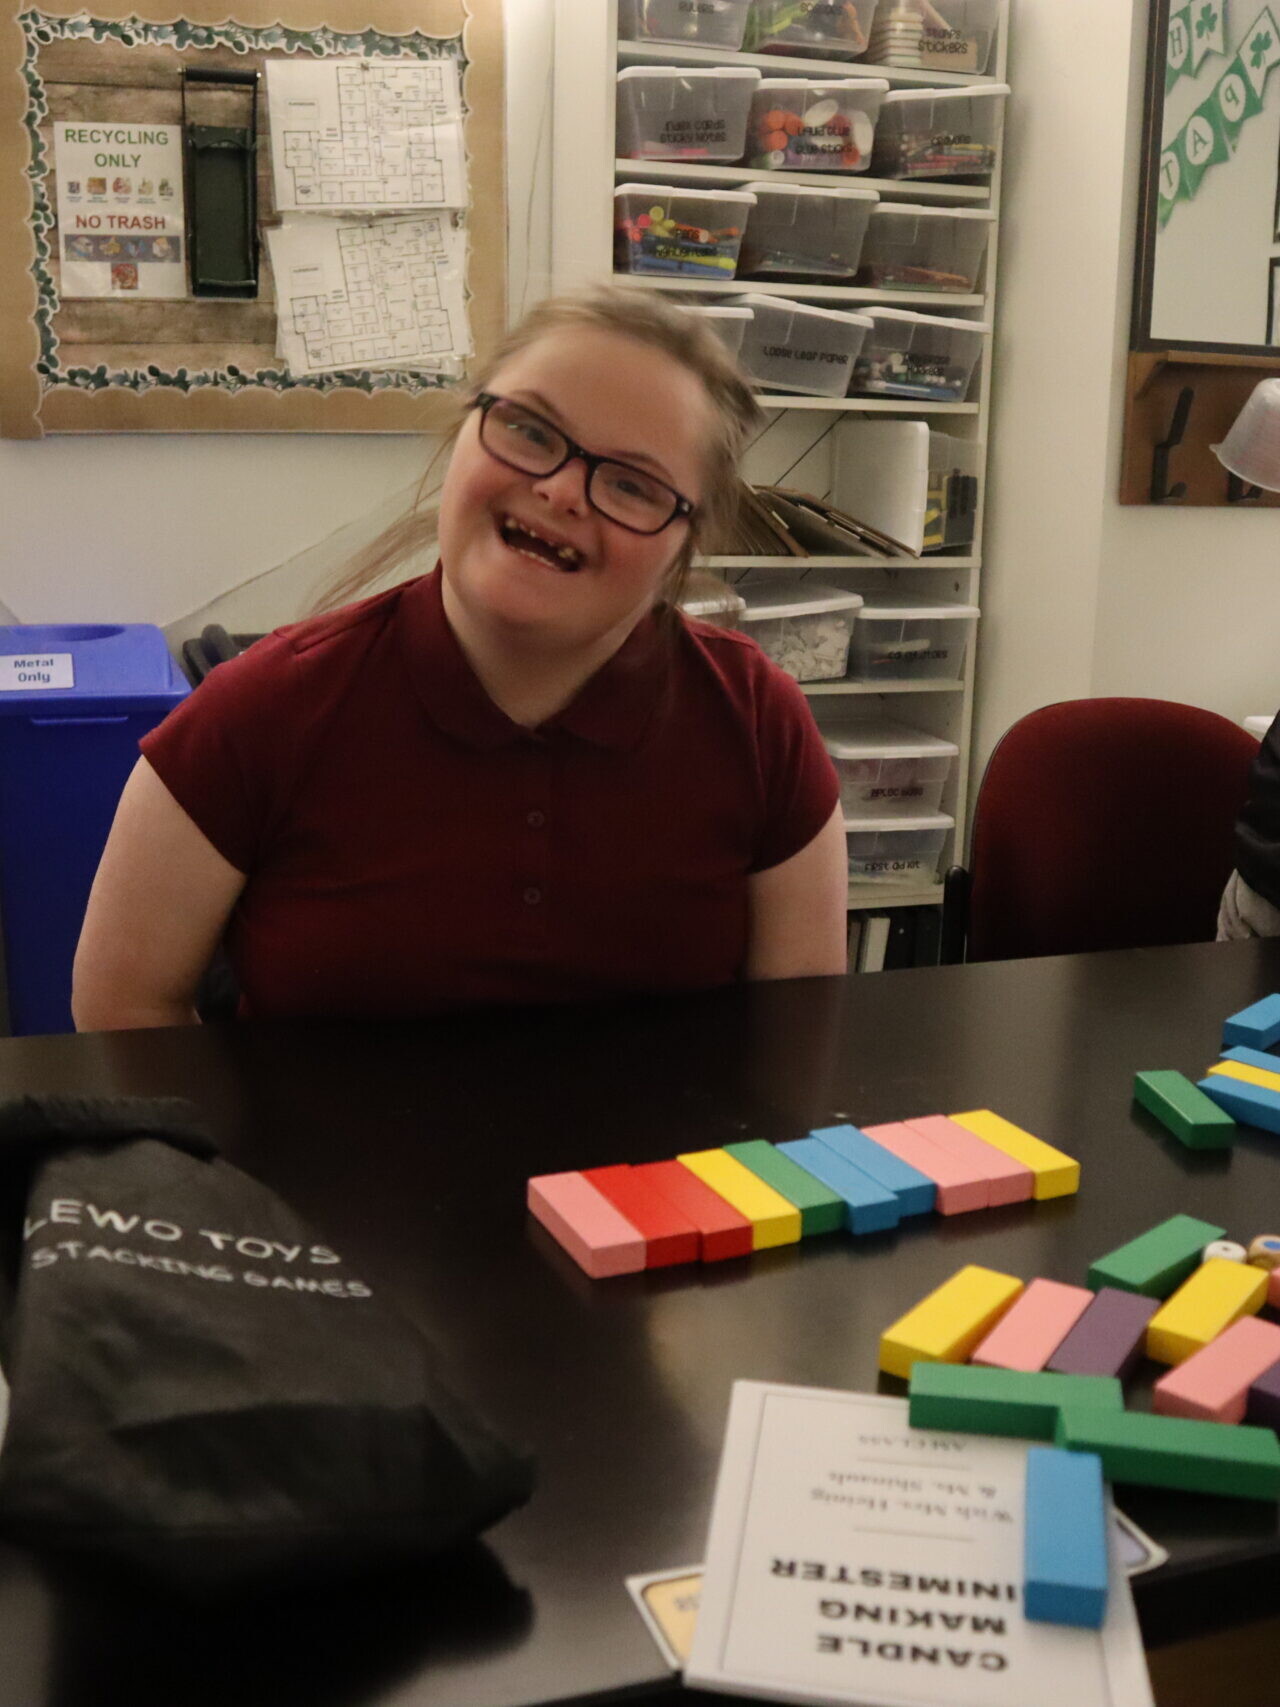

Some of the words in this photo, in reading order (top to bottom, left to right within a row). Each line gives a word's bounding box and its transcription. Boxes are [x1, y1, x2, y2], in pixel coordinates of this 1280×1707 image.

[65, 129, 168, 145] RECYCLING
[95, 154, 142, 168] ONLY
[76, 215, 101, 229] NO
[107, 216, 166, 230] TRASH
[14, 659, 54, 668] Metal
[18, 672, 51, 683] Only
[199, 1228, 341, 1265] TOYS
[31, 1241, 235, 1283] STACKING
[242, 1271, 373, 1298] GAMES
[769, 1558, 1018, 1602] INIMESTER
[819, 1600, 1007, 1635] MAKING
[816, 1632, 1009, 1672] CANDLE
